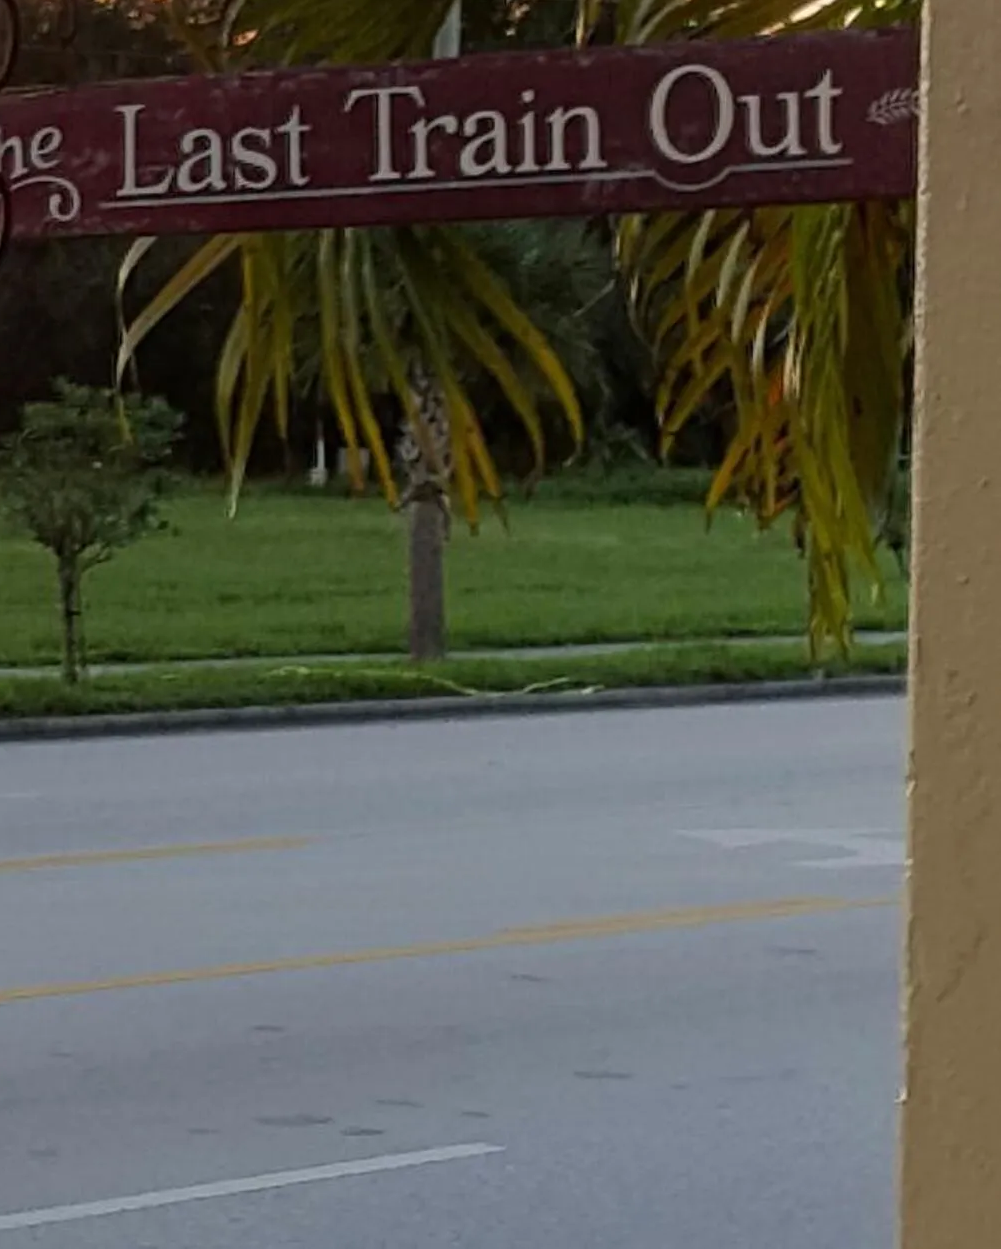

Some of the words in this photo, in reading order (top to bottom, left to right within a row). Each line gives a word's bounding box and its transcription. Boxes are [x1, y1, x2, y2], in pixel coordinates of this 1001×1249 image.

[115, 104, 313, 197] Last
[343, 85, 607, 182] Train
[649, 64, 844, 164] Out
